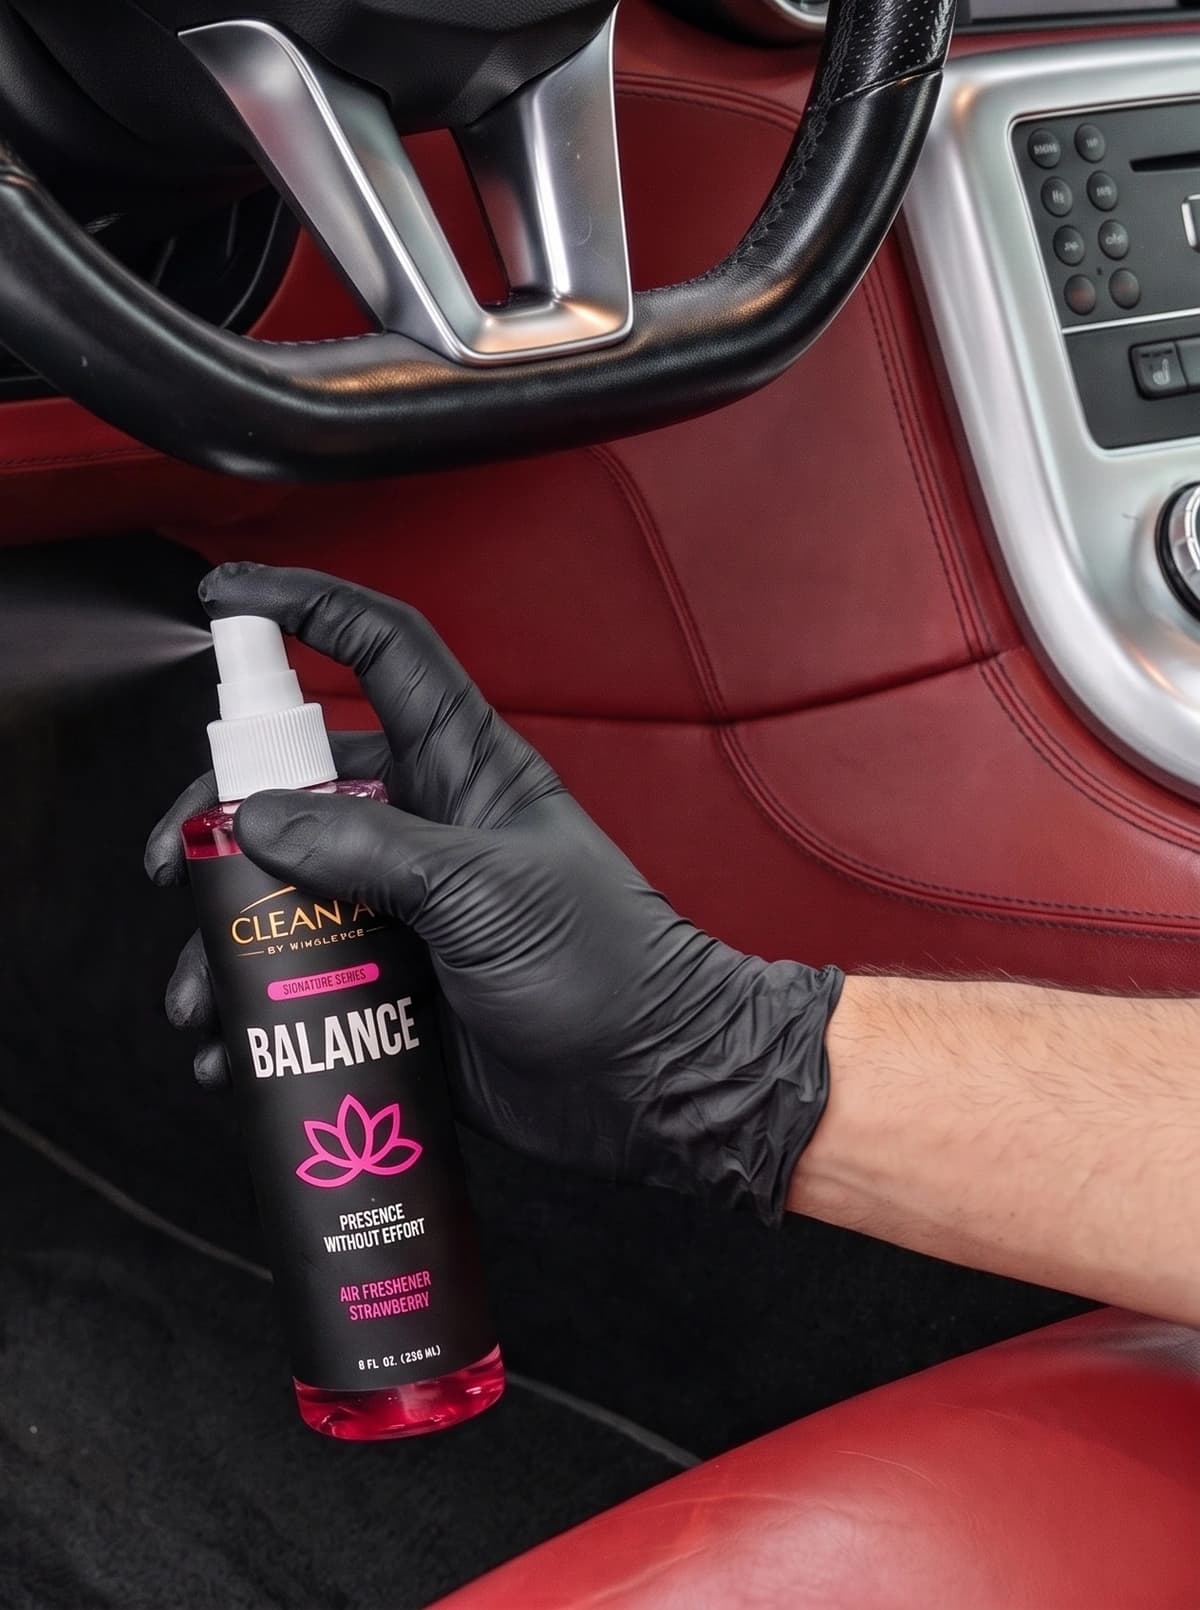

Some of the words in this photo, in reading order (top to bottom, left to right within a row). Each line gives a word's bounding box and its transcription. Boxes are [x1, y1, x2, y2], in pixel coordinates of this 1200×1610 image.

[231, 900, 342, 945] CLEAN
[267, 944, 284, 955] BY
[246, 996, 420, 1079] BALANCE
[339, 1203, 406, 1231] PRESENCE
[323, 1229, 380, 1253] WITHOUT
[382, 1217, 426, 1244] EFFORT
[339, 1284, 361, 1303] AIR
[362, 1271, 432, 1300] FRESHENER
[349, 1291, 430, 1321] STRAWBERRY
[366, 1358, 379, 1369] FL
